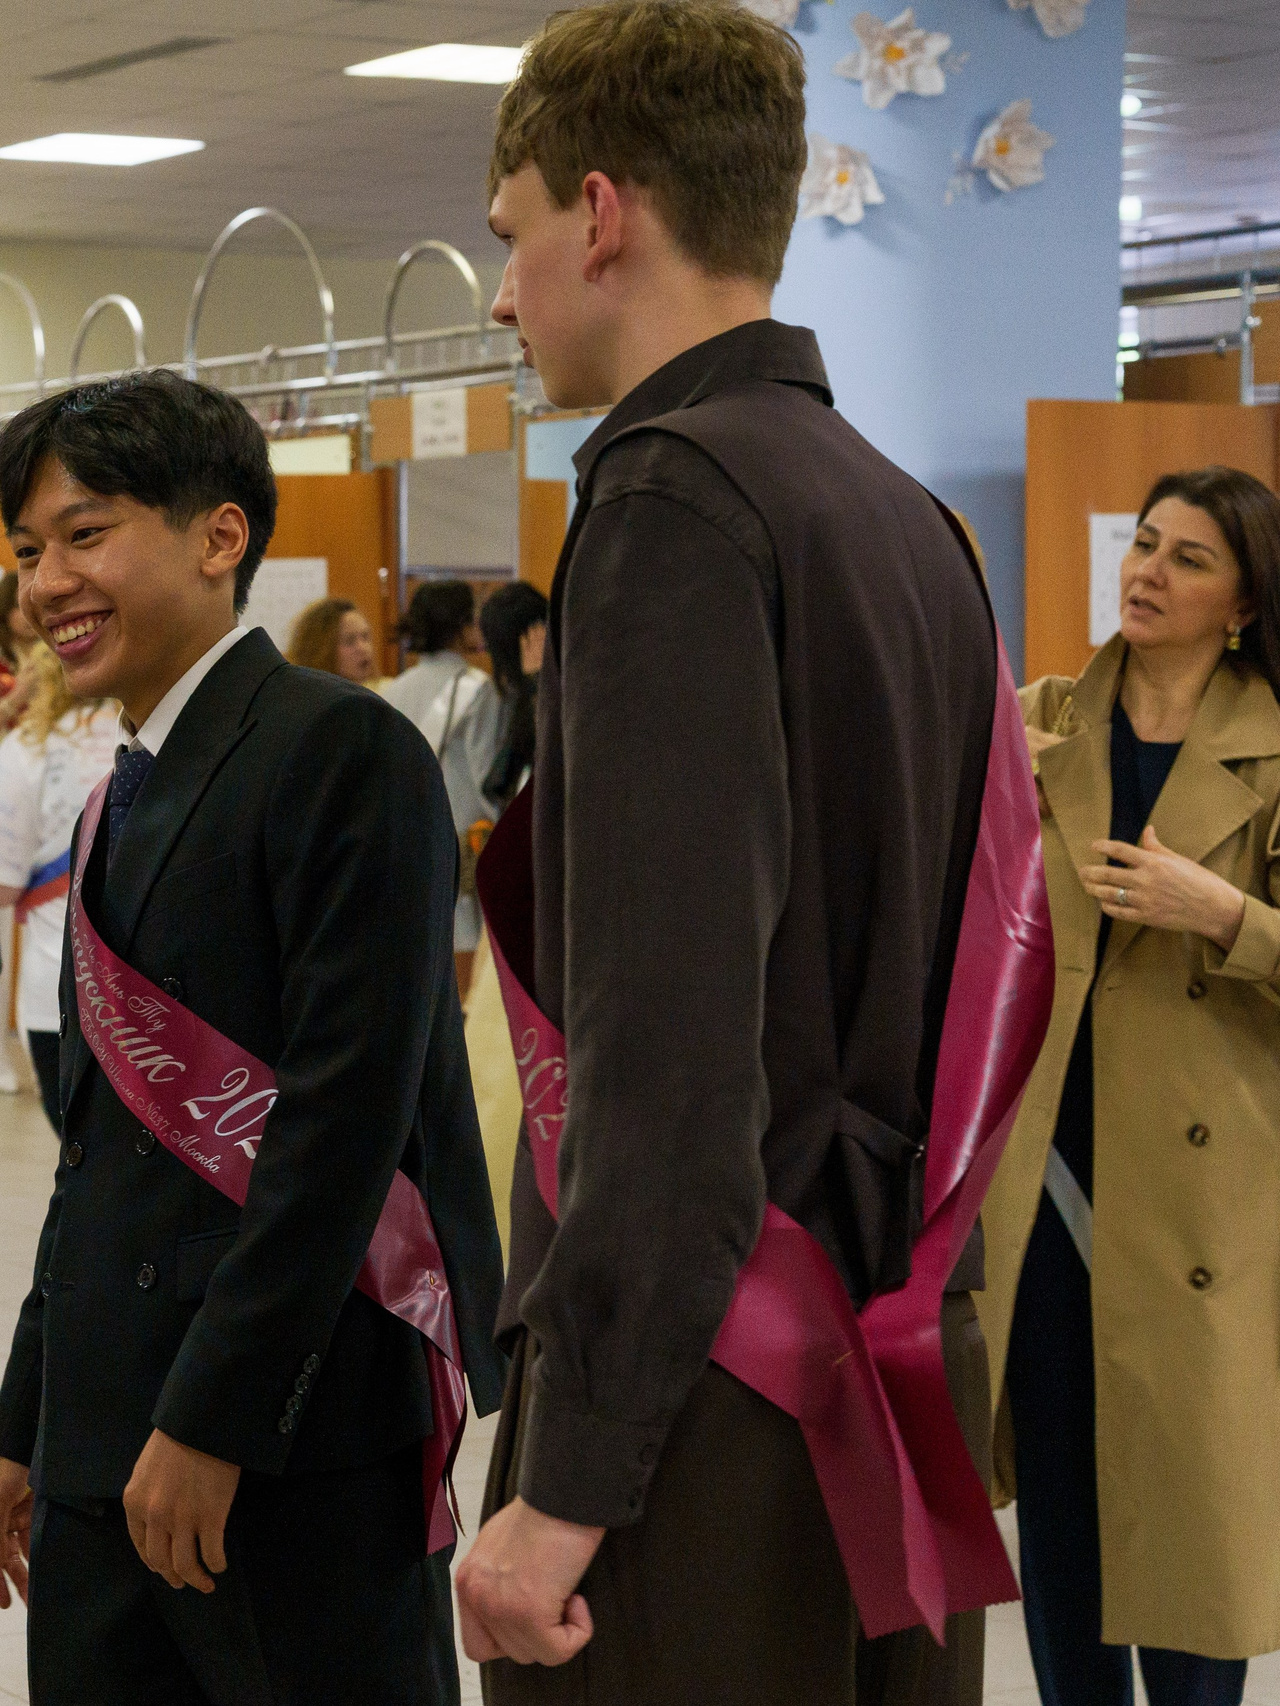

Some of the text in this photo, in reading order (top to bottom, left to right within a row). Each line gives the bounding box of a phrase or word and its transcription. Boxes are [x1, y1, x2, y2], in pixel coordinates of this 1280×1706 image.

[70, 836, 186, 1083] пускник
[95, 961, 125, 1000] Ань
[127, 996, 171, 1034] Ту
[106, 1054, 135, 1101] Школа
[170, 1130, 221, 1174] Москва
